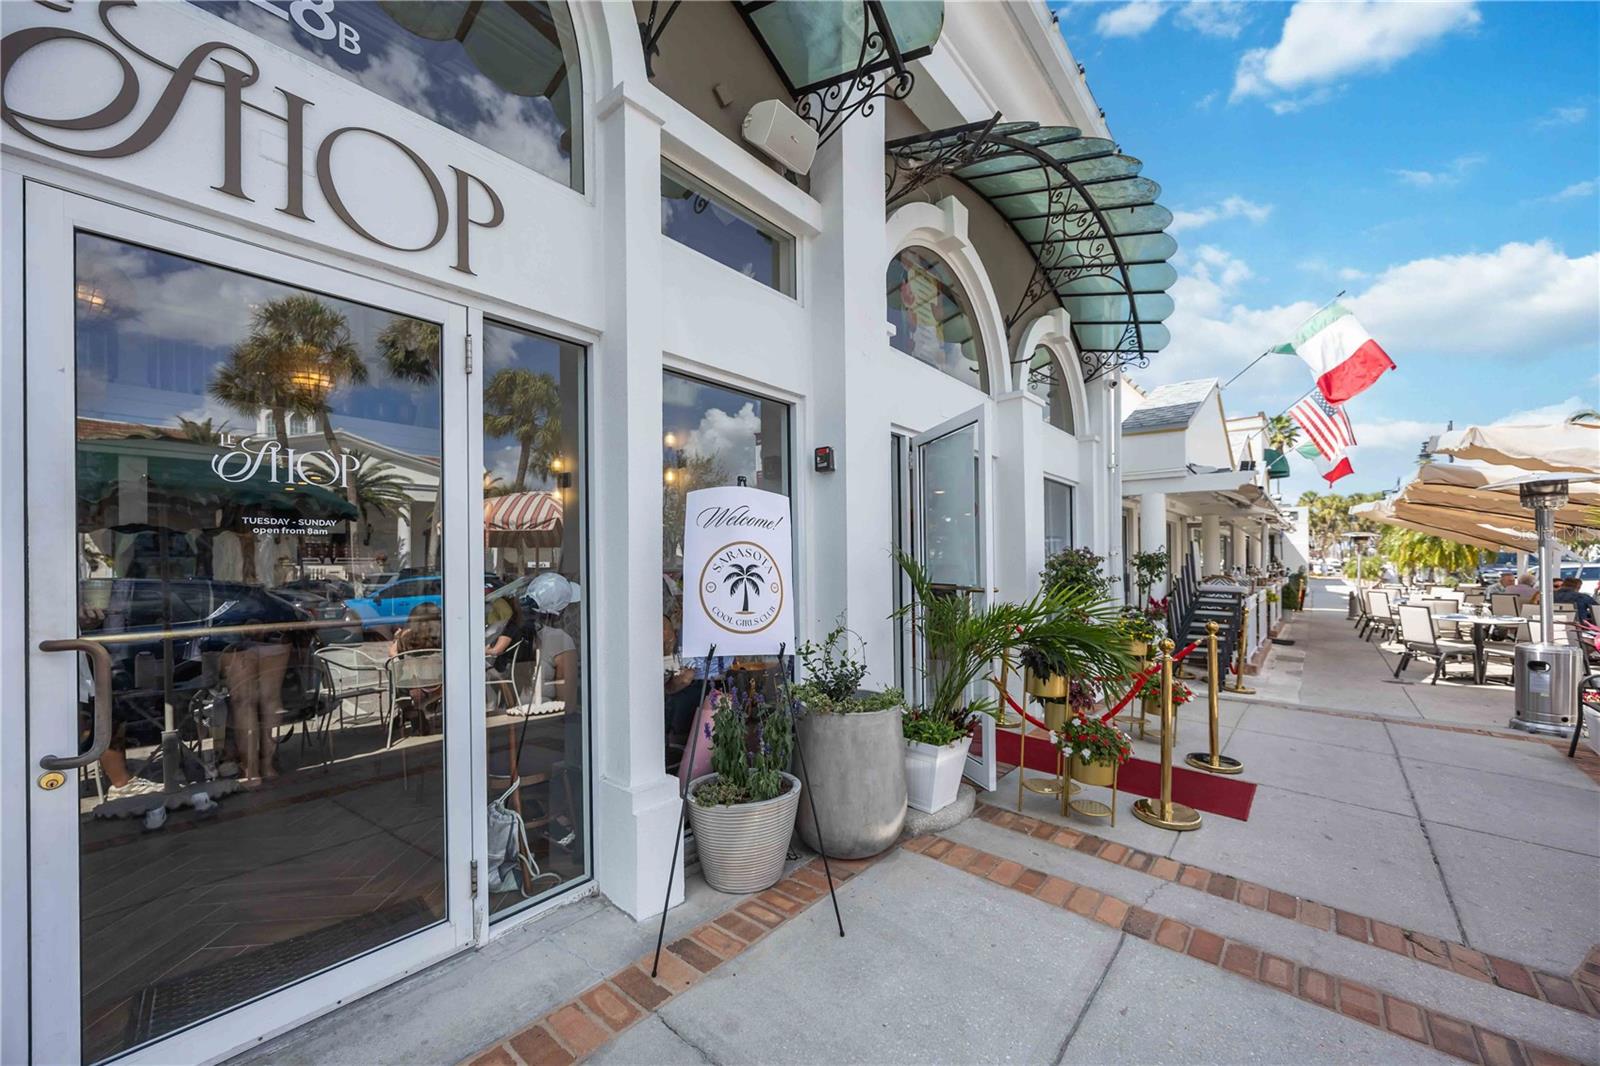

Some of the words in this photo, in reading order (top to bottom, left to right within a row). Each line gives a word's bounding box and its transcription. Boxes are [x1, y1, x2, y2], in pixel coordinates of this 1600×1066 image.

[248, 0, 361, 55] 8B
[0, 0, 505, 276] SHOP
[211, 438, 360, 488] SHOP
[241, 516, 290, 525] TUESDAY
[298, 518, 337, 527] SUNDAY
[697, 505, 783, 530] Welcome!
[252, 527, 280, 535] open
[281, 526, 306, 535] from
[307, 527, 328, 535] 8am
[712, 548, 773, 573] SARASOTA
[712, 606, 734, 625] COOL
[735, 617, 760, 627] GIRLS
[760, 606, 776, 623] CLUB
